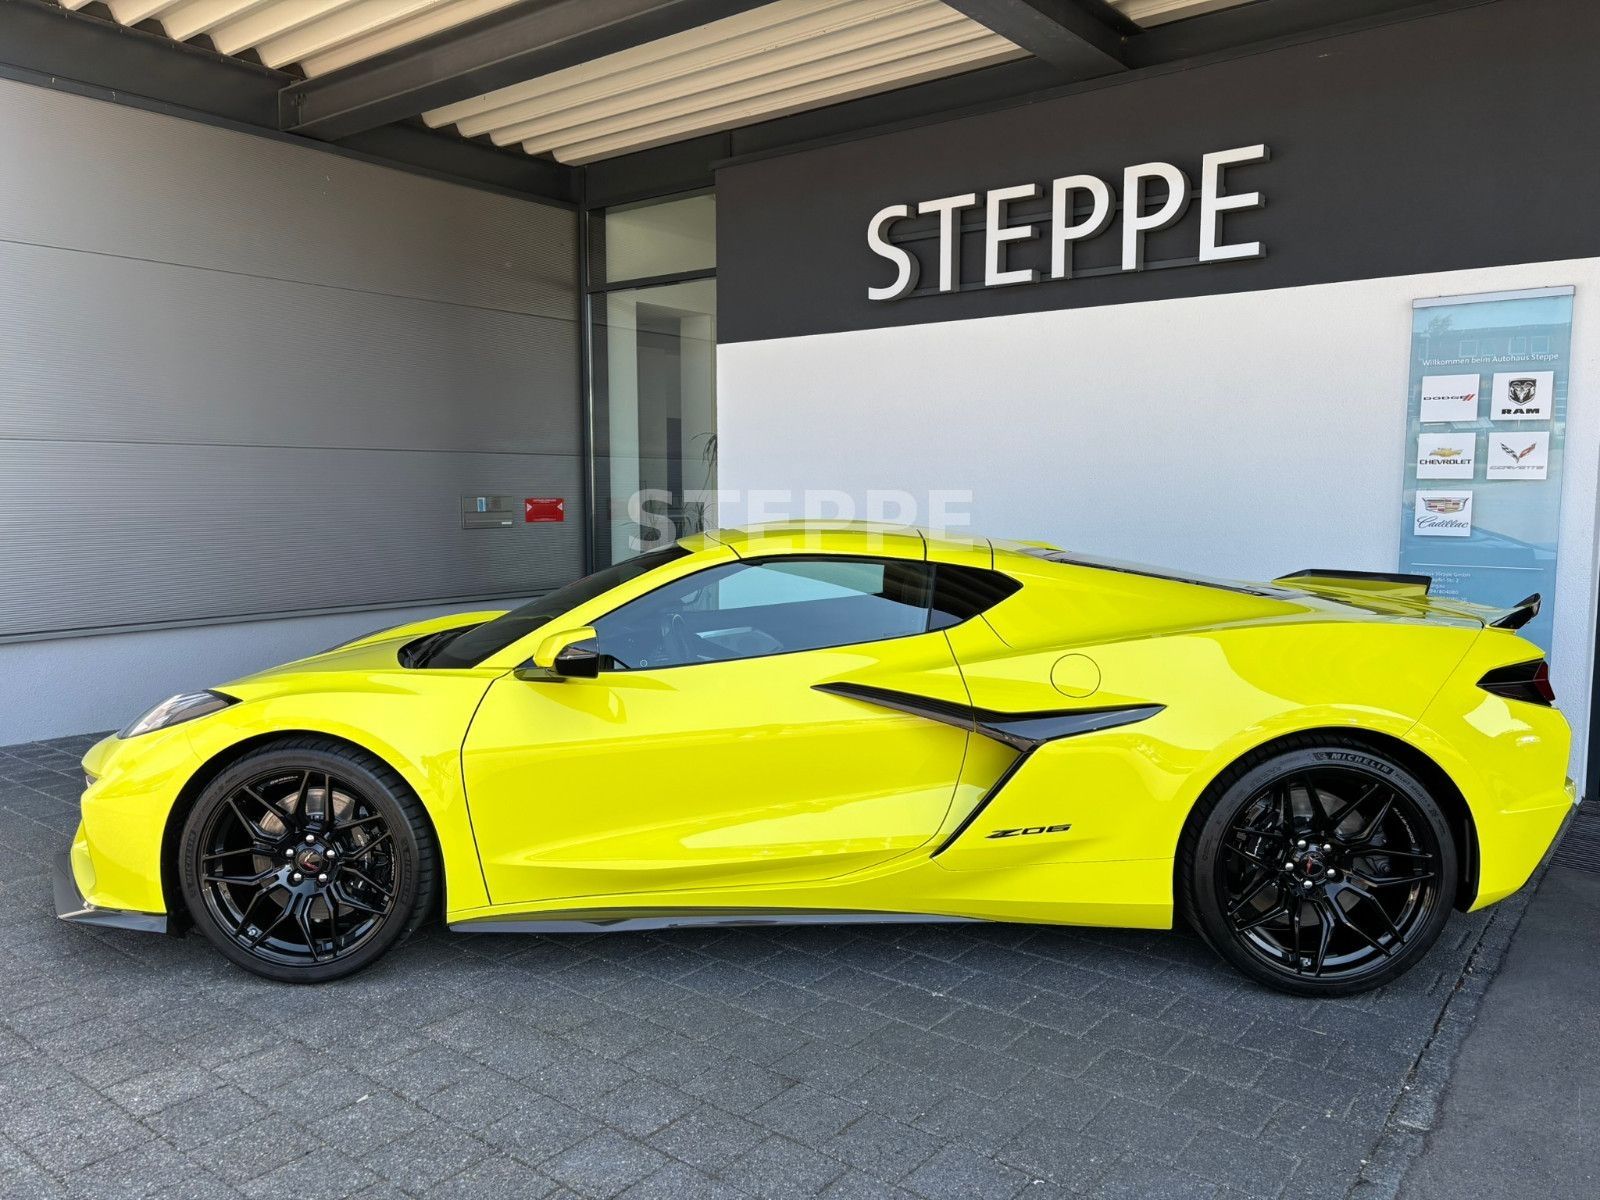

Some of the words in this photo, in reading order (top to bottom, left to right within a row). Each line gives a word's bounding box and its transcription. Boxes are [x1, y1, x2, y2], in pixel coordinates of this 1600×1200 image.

[867, 143, 1269, 301] STEPPE
[1423, 358, 1470, 366] Willkommen
[1472, 356, 1491, 364] beim
[1492, 354, 1530, 362] Autohaus
[1531, 352, 1559, 361] Steppe
[1416, 515, 1469, 529] Cadillac
[1331, 752, 1390, 773] MICHELIN
[985, 823, 1072, 839] Z06
